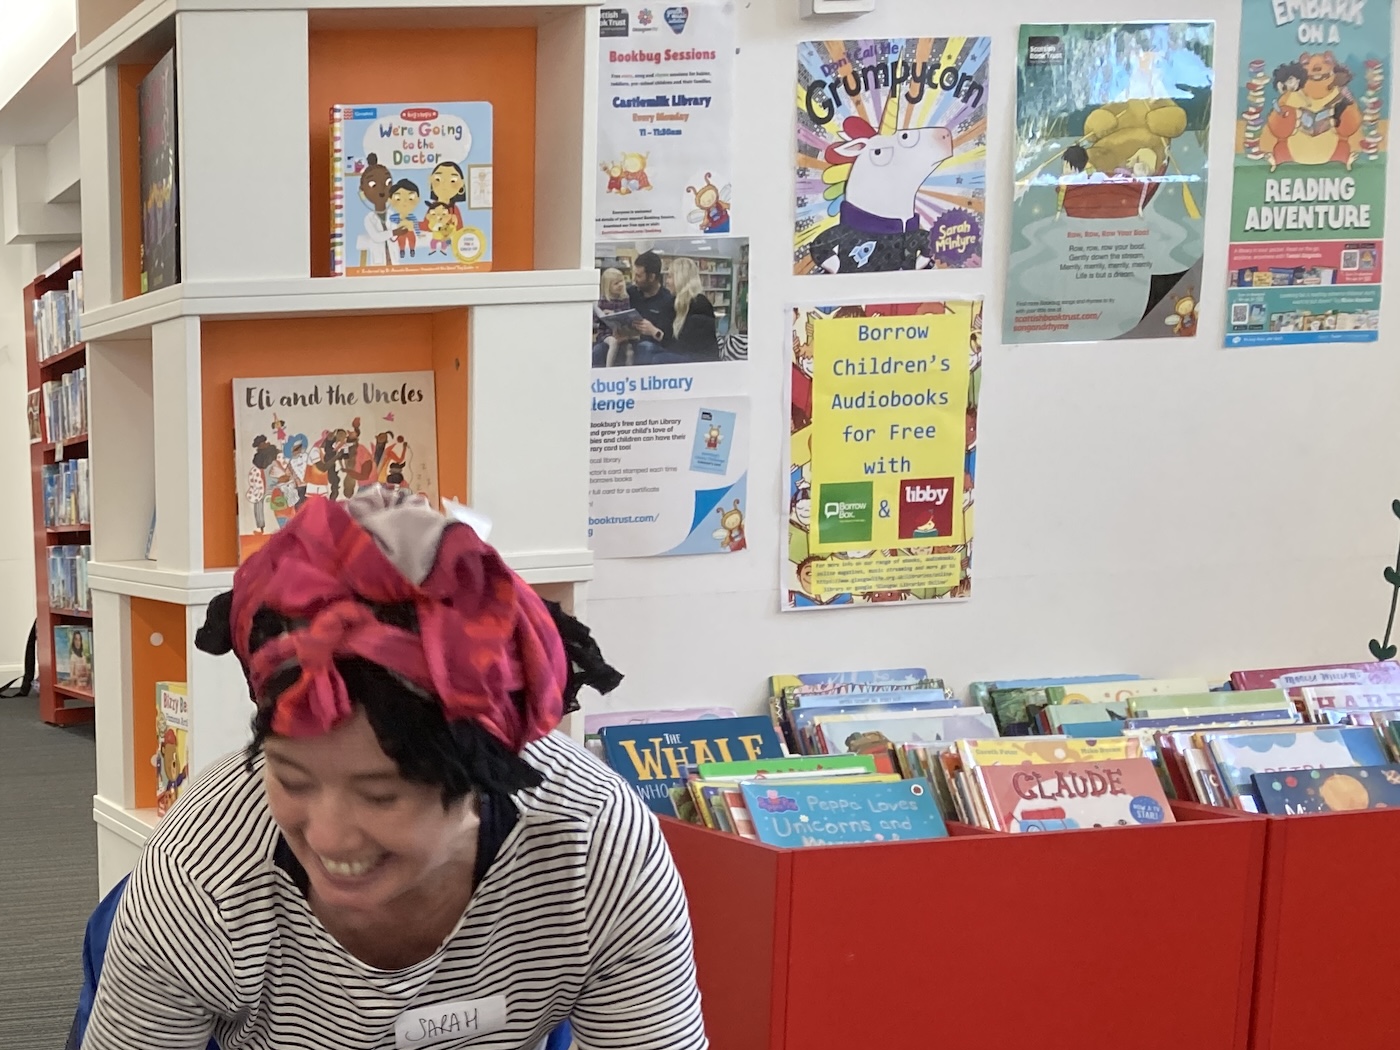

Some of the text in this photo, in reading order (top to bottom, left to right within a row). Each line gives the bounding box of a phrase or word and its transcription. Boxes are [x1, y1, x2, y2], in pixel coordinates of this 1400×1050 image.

[1298, 23, 1340, 44] ON A
[609, 48, 716, 64] Bookbug Sessions
[853, 45, 878, 61] Call
[881, 42, 899, 55] Me
[612, 94, 712, 108] Castlemilk Library
[806, 59, 984, 125] Grumpycorn
[632, 112, 689, 122] Every Monday
[379, 122, 462, 140] We're Going
[402, 138, 435, 149] to the
[393, 150, 442, 166] Doctor
[1264, 177, 1356, 204] READING
[1244, 204, 1371, 232] ADVENTURE
[938, 220, 971, 240] Sarah
[858, 325, 930, 341] Borrow
[832, 355, 951, 376] Children's
[641, 376, 693, 393] Library
[246, 381, 424, 408] Eli and the Uncles
[831, 389, 949, 410] Audiobooks
[842, 424, 936, 443] for Free
[864, 456, 911, 475] with
[839, 485, 949, 518] Borrow & libby
[163, 692, 179, 715] Bizzy
[663, 733, 682, 745] THE
[636, 783, 670, 801] WHO
[1012, 767, 1127, 802] CLAUDE
[806, 796, 862, 814] Peppa
[867, 799, 918, 813] Loves
[772, 816, 912, 838] Unicorns and
[404, 1008, 480, 1042] SARAH
